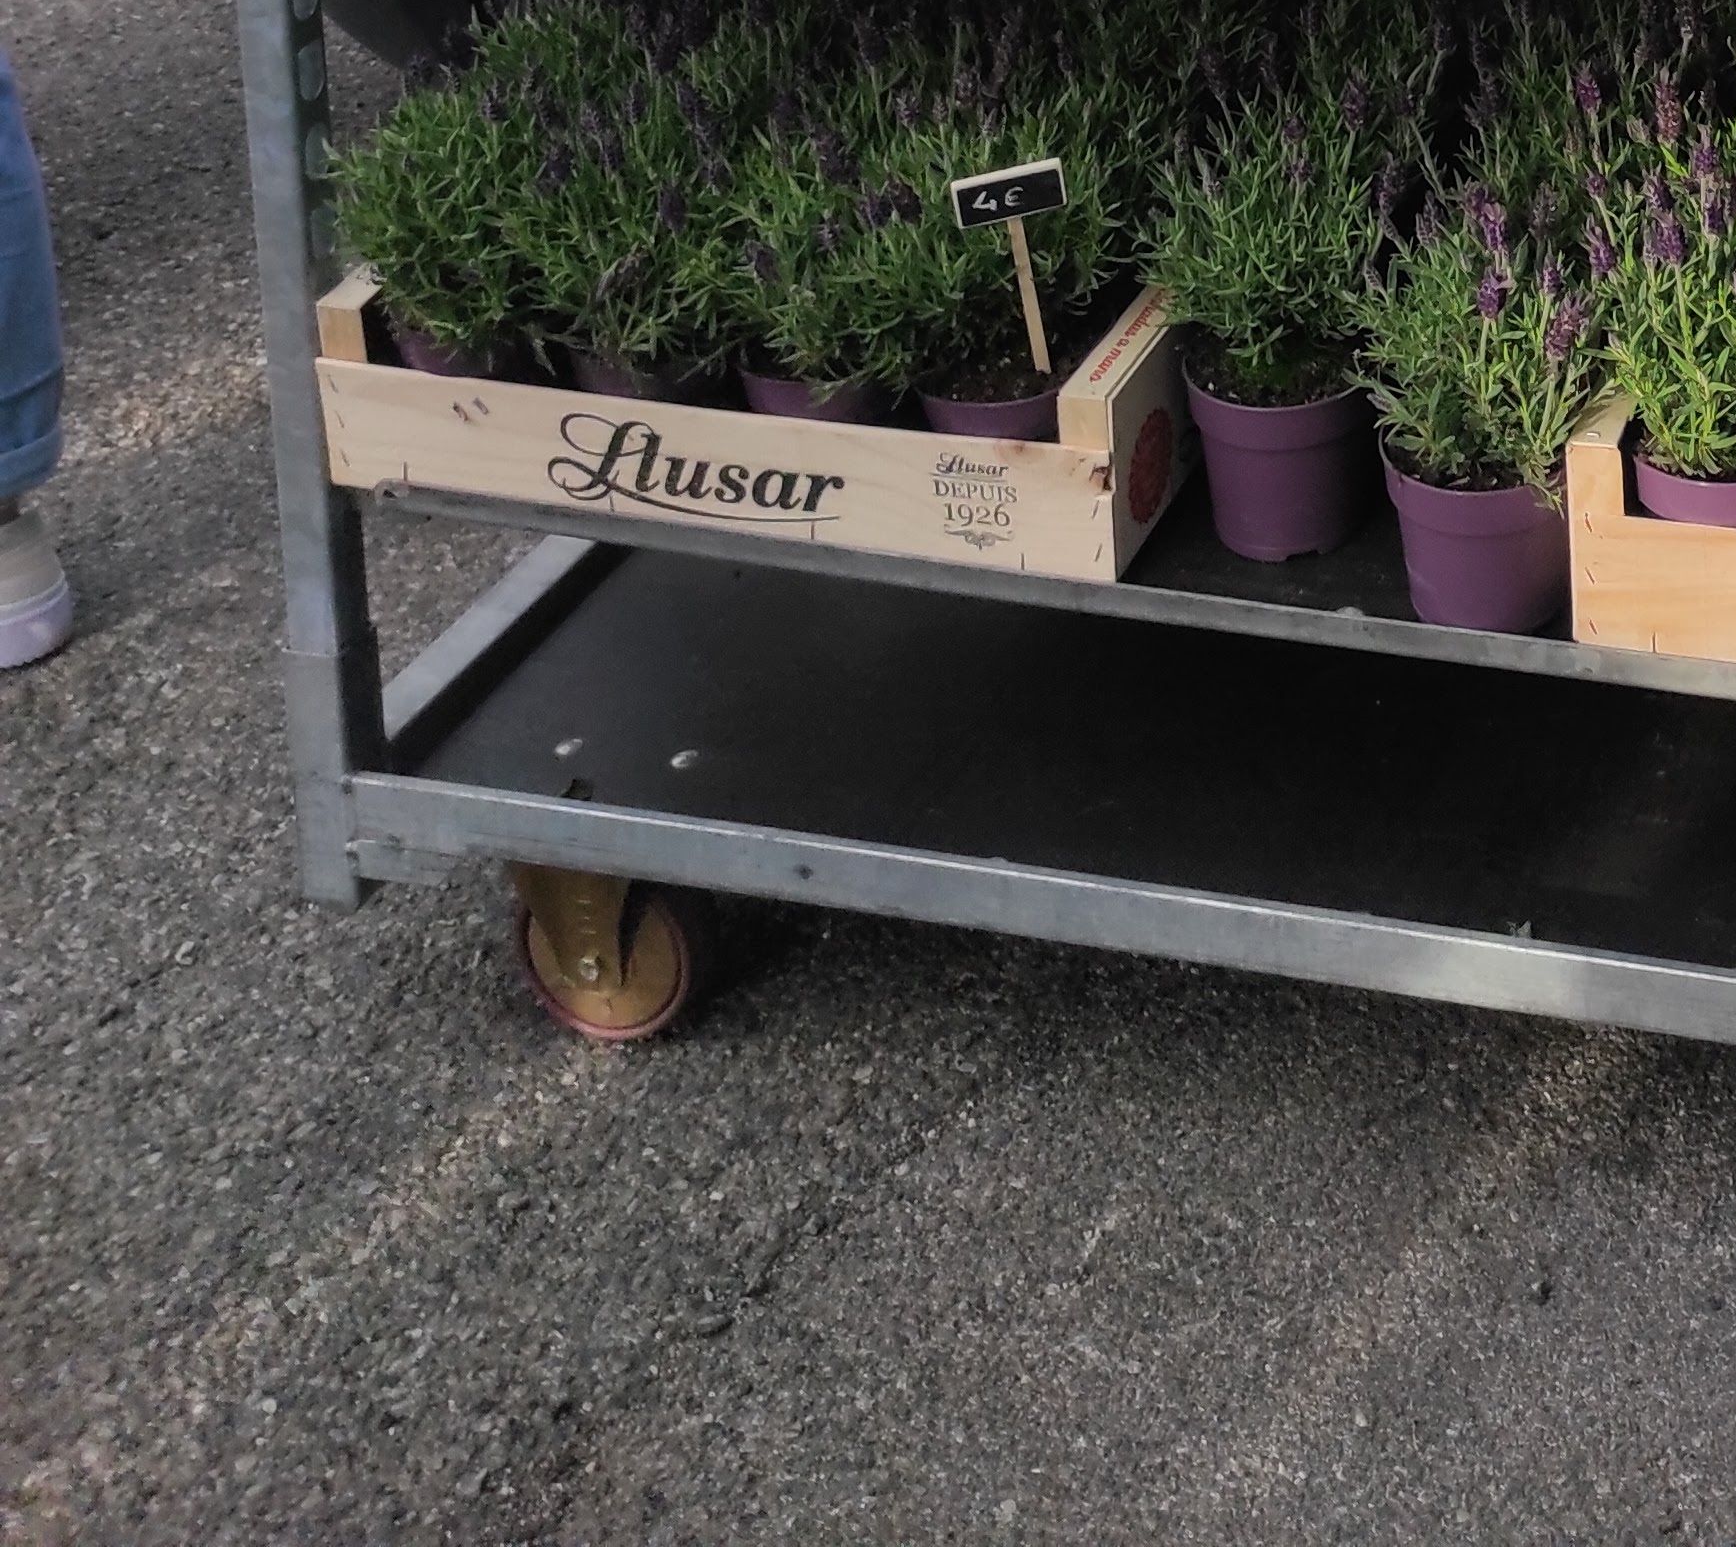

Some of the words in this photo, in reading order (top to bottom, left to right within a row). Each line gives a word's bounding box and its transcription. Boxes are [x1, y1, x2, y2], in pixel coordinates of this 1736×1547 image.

[547, 413, 845, 521] Llusar
[935, 452, 1009, 478] Llusar
[934, 479, 1018, 504] DEPUIS
[944, 504, 1011, 528] 1926
